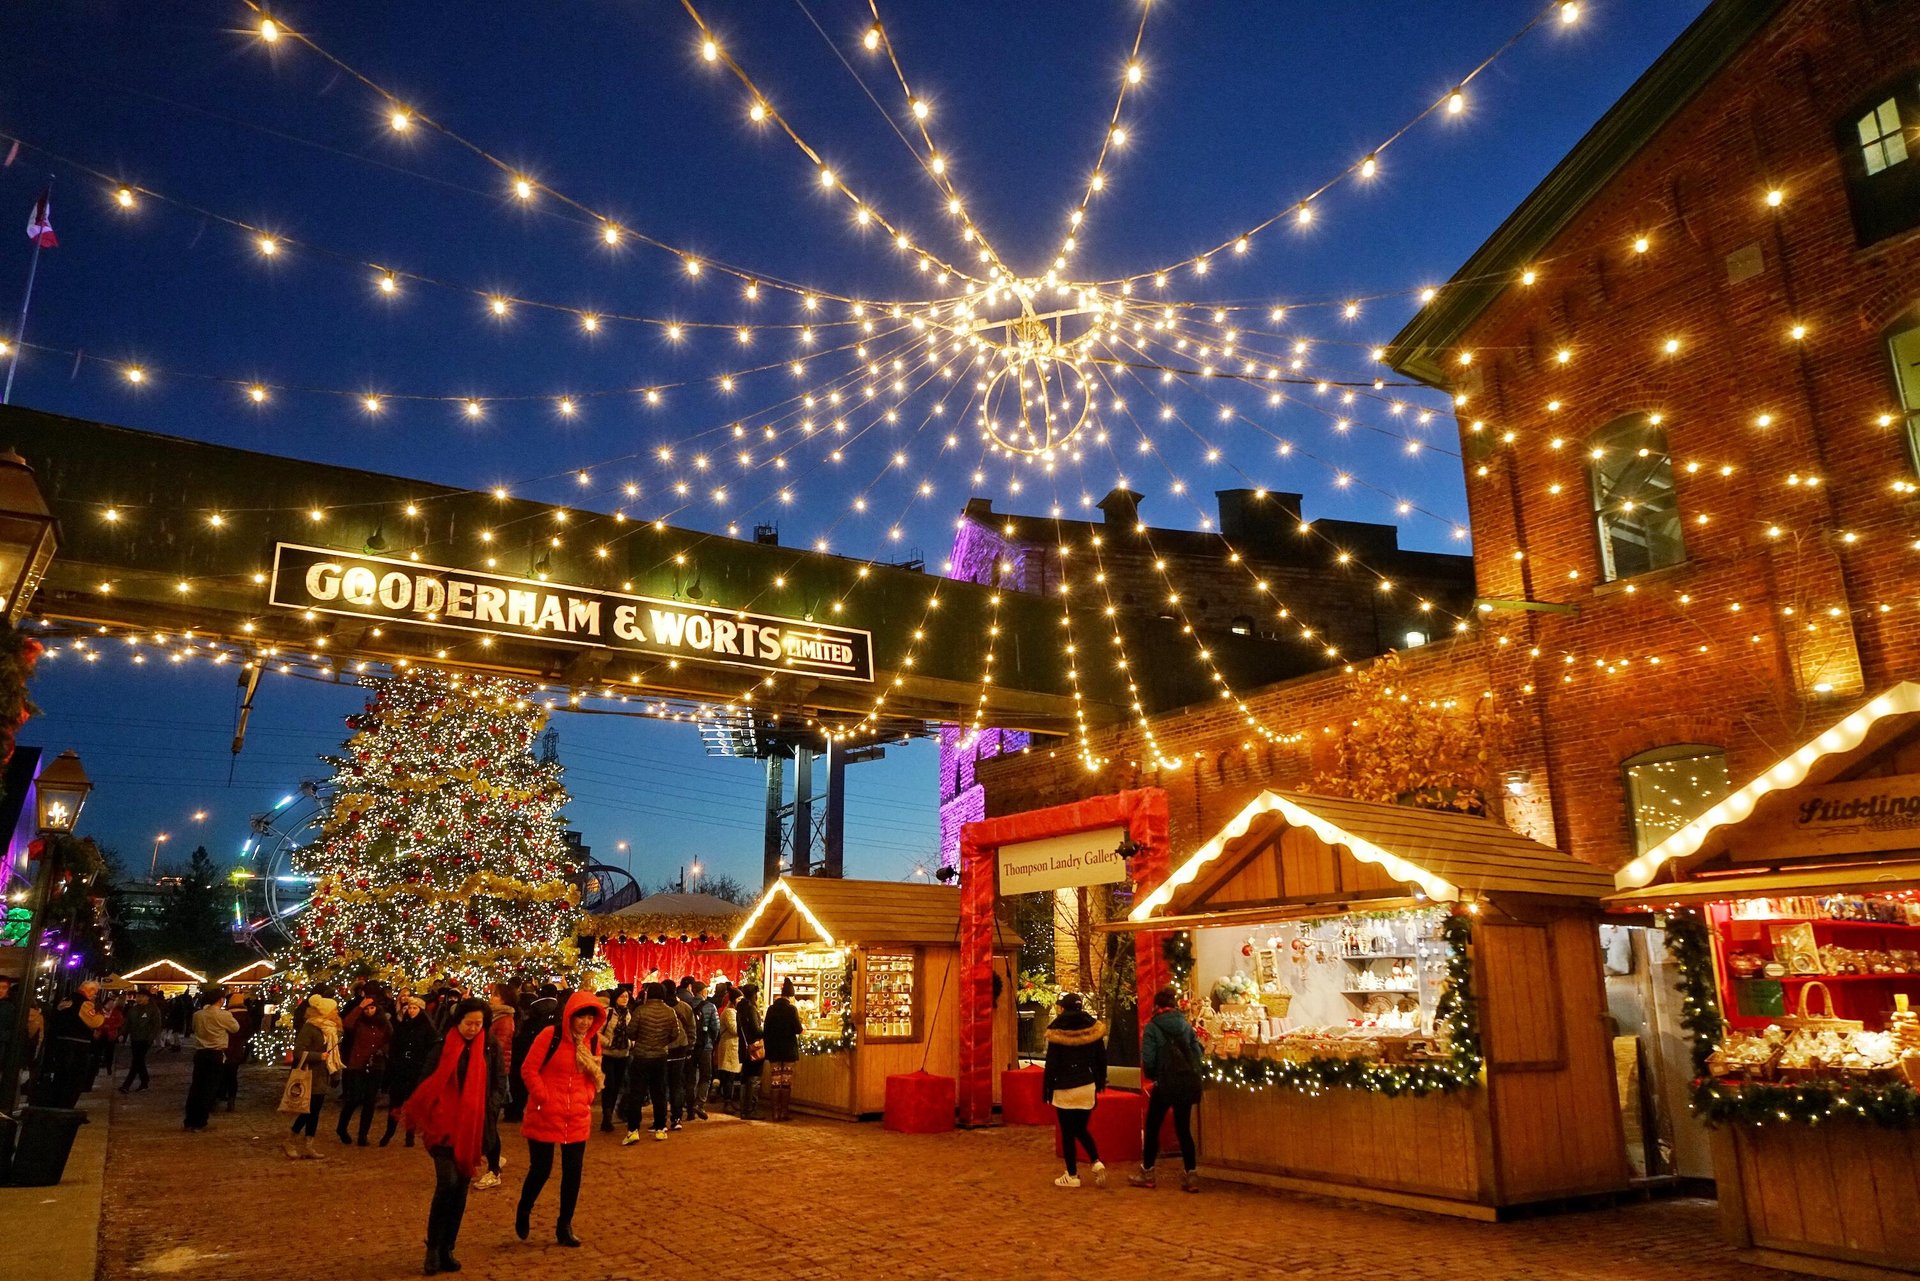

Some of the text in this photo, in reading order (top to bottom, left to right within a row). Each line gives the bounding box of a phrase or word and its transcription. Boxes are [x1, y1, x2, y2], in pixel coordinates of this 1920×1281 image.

[305, 562, 853, 663] GOODERHAM & WORTS LIMITED
[1004, 849, 1119, 876] Thompson Landry Gallery
